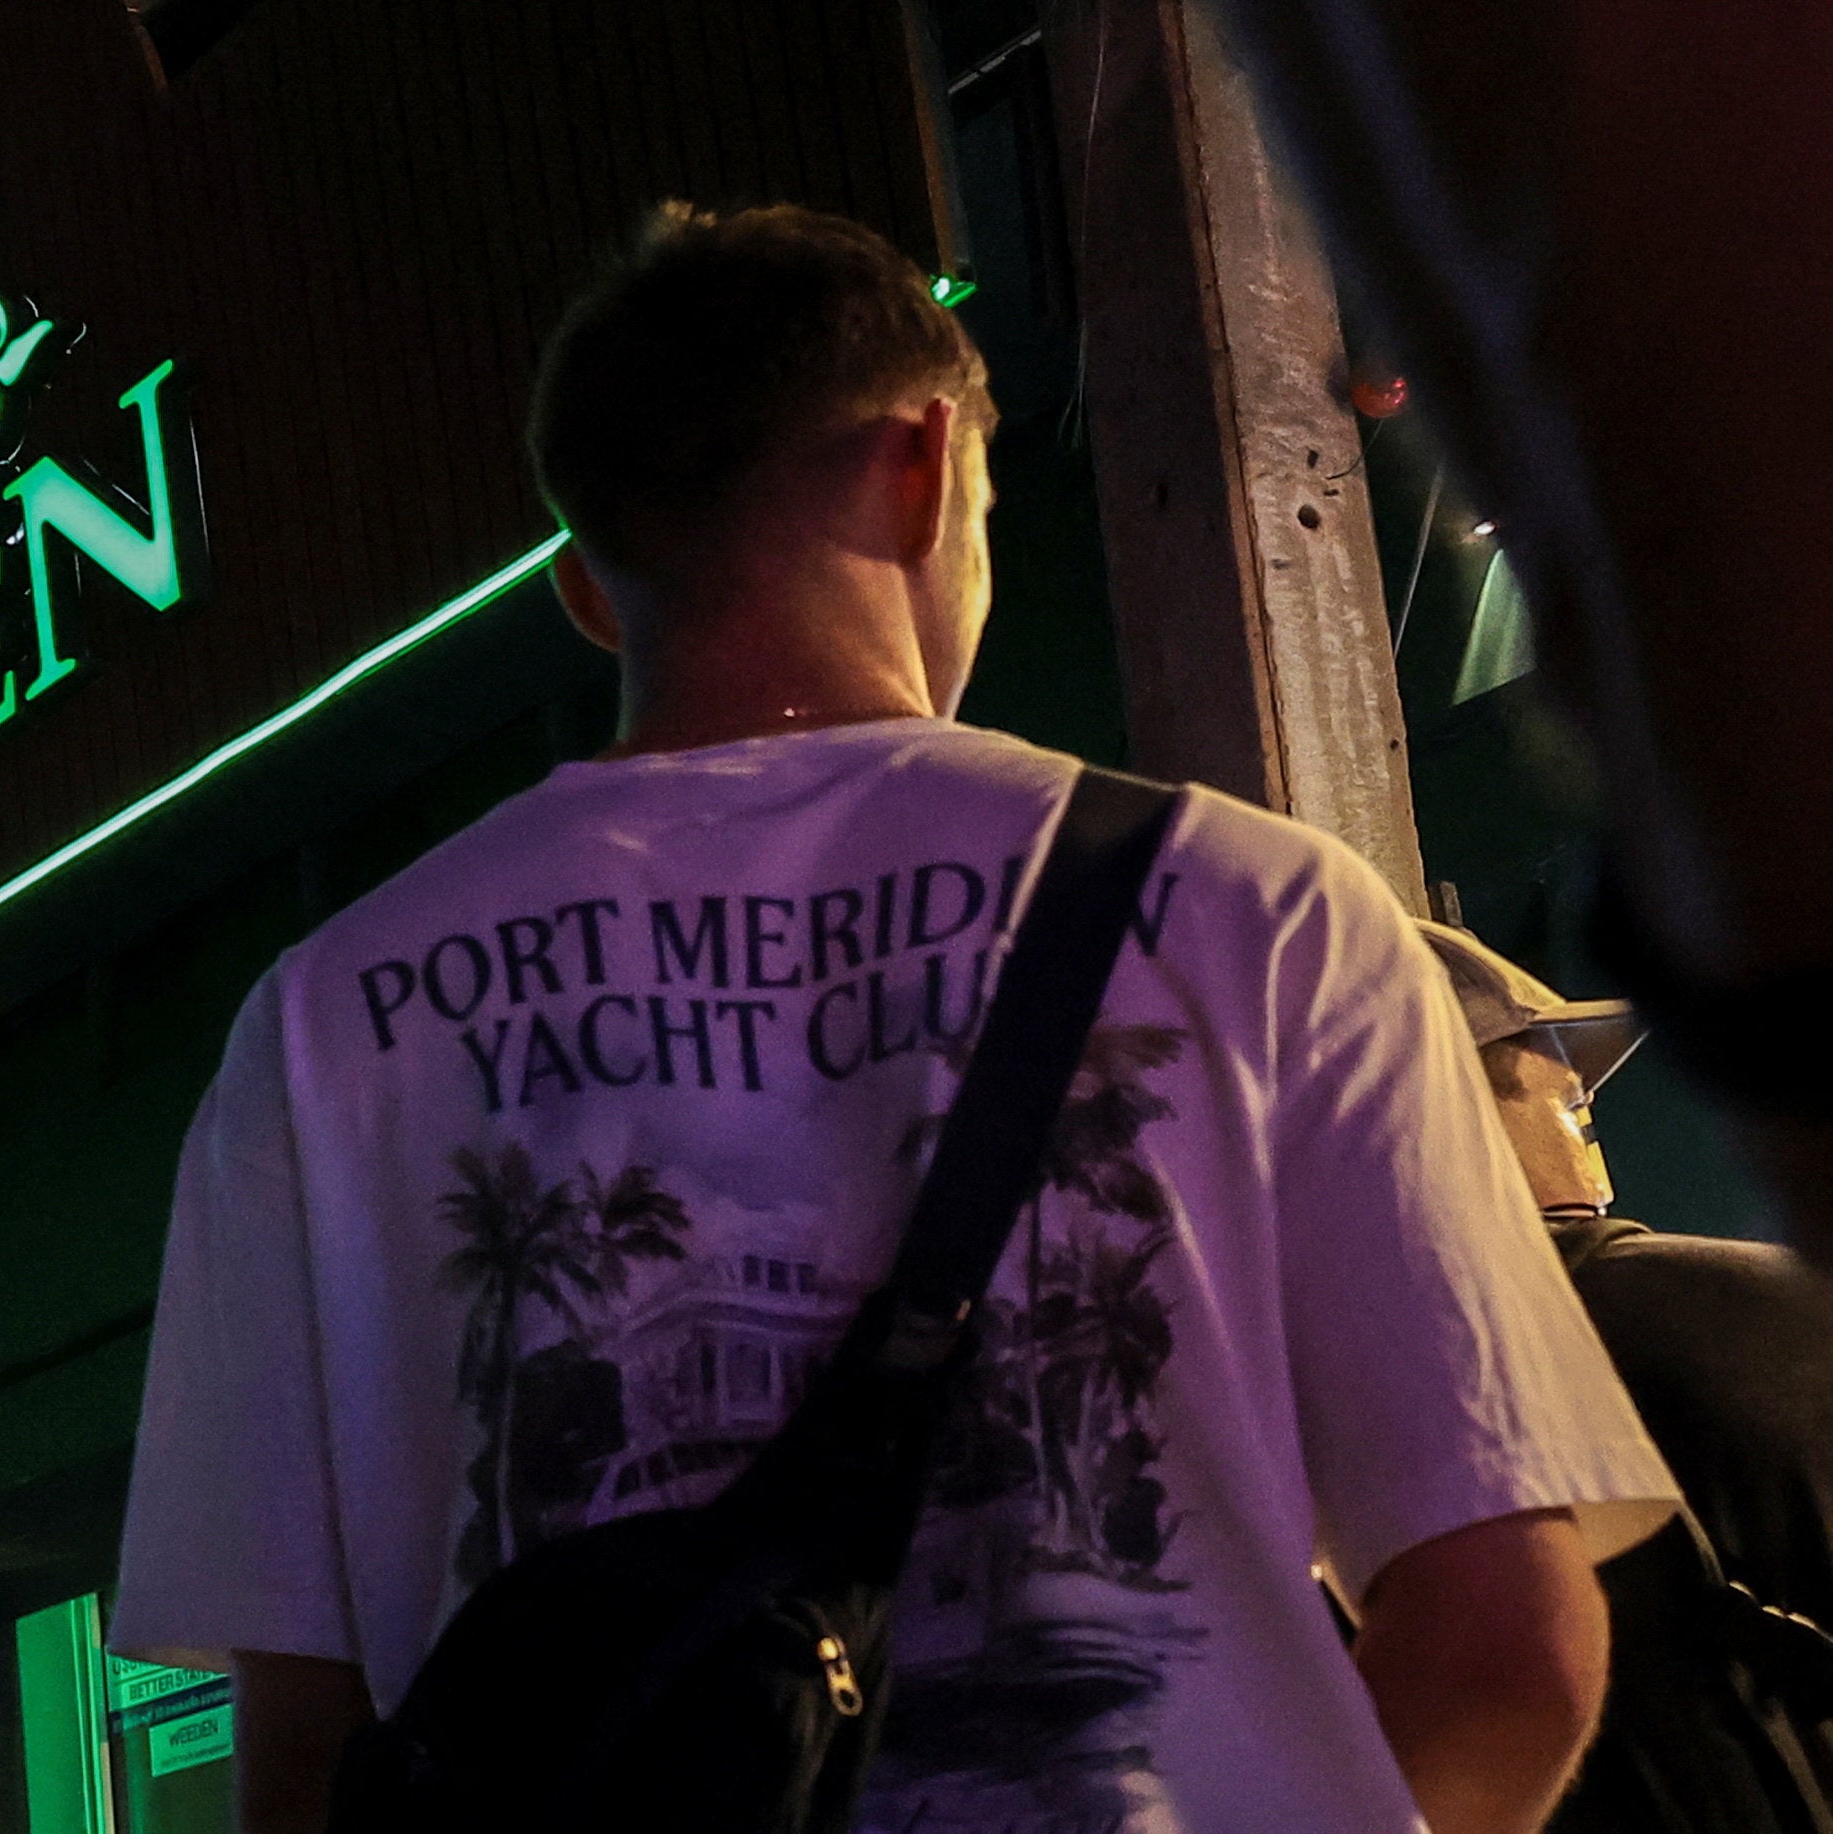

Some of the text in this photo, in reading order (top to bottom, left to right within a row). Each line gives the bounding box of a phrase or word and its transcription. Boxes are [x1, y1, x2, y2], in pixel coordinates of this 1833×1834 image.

[358, 855, 1179, 1052] PORT MERIDIN
[461, 950, 988, 1113] YACHT CLU
